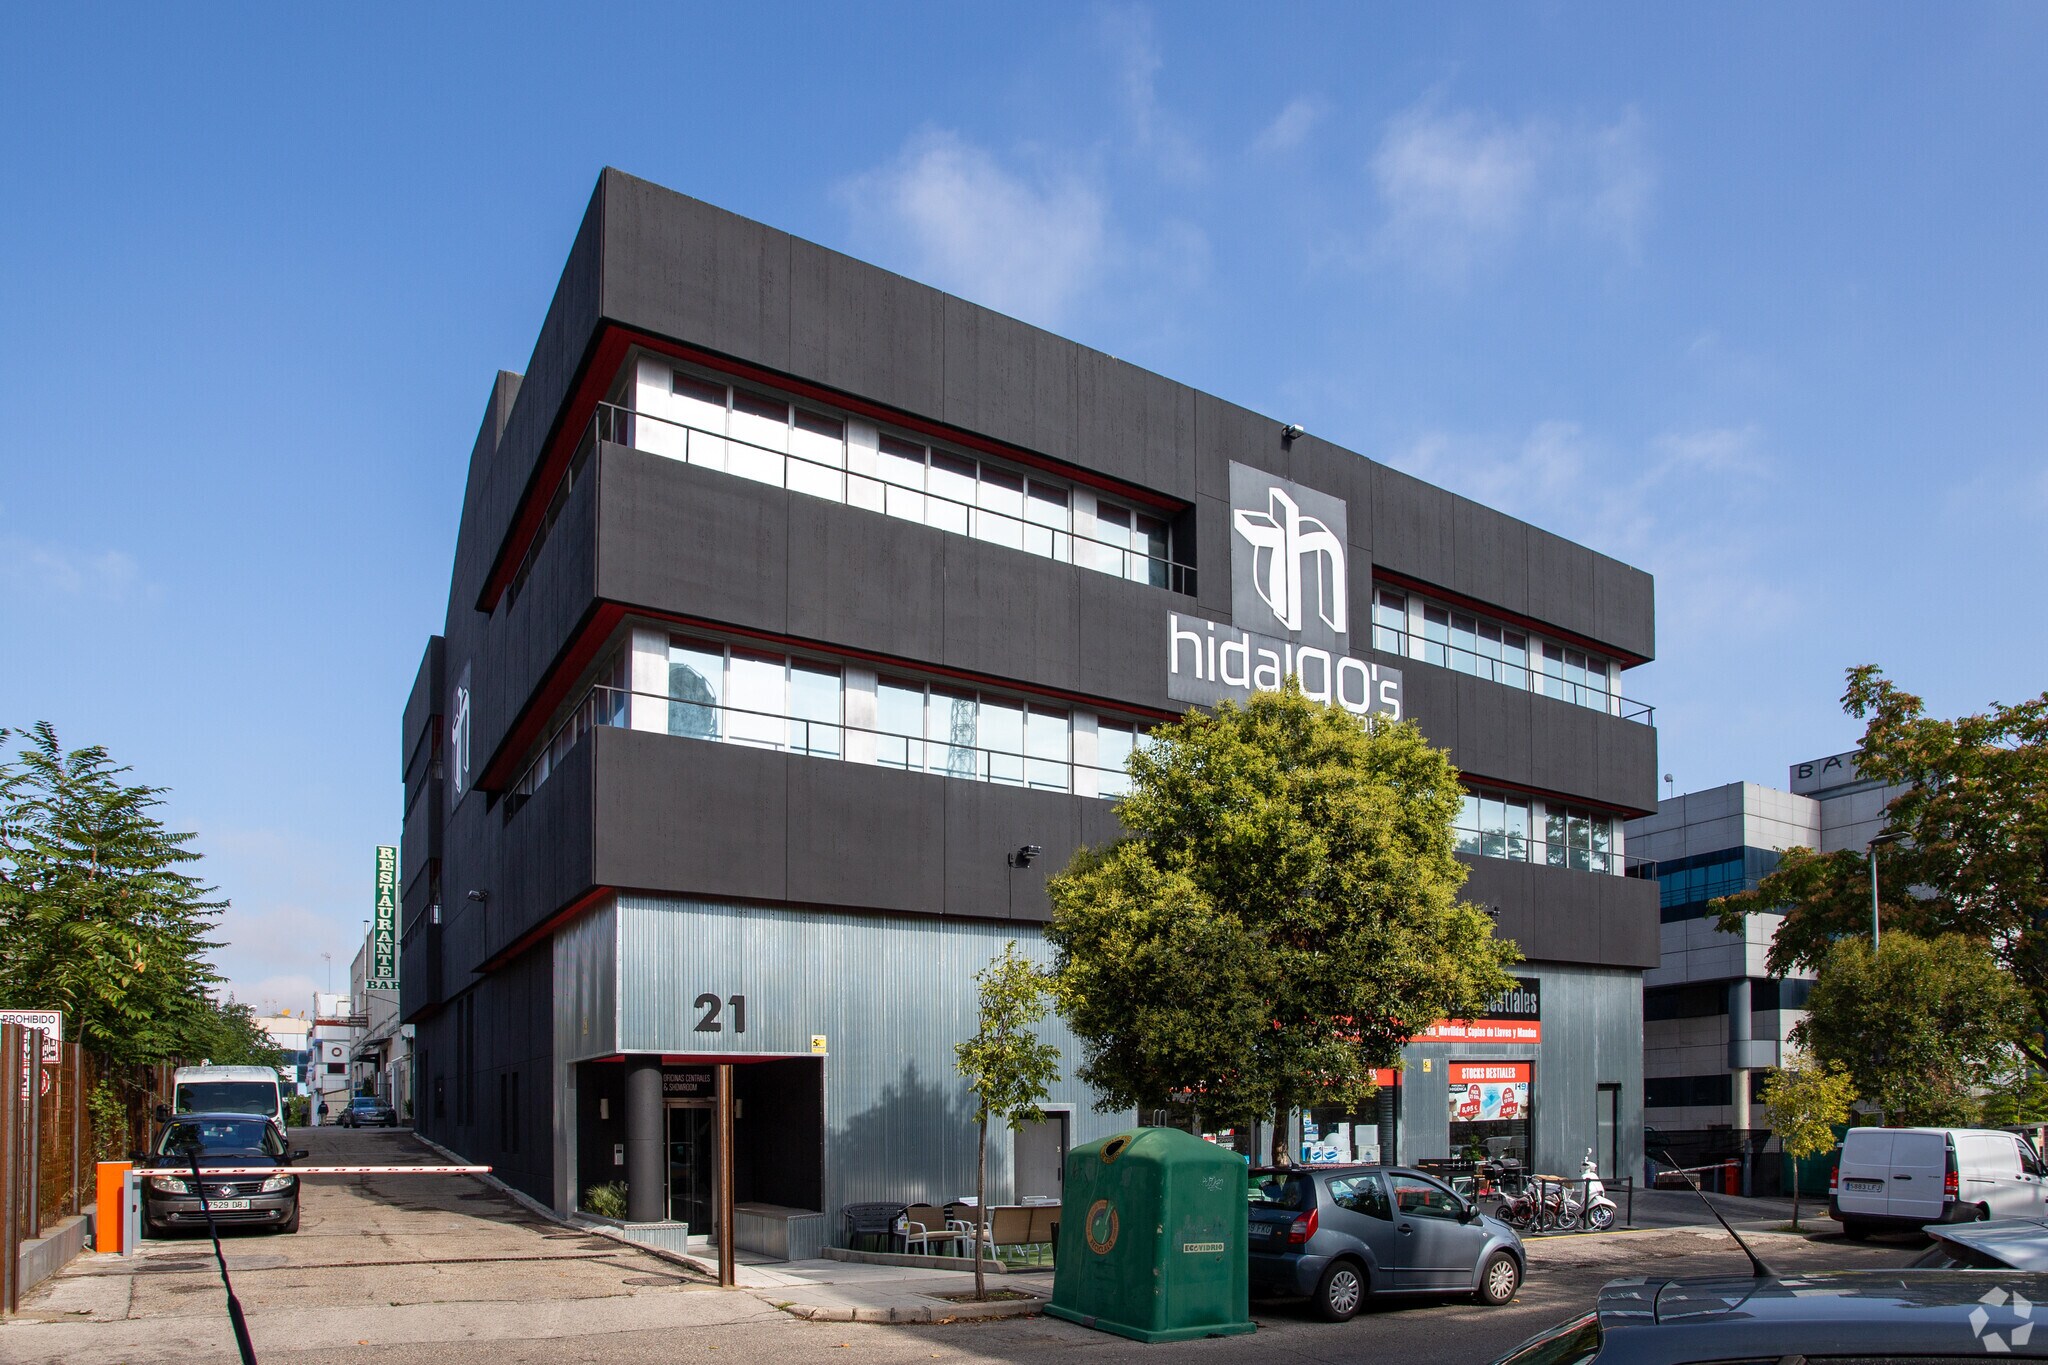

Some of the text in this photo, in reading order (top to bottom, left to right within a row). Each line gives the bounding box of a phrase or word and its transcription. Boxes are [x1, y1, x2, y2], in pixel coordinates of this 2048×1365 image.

[1169, 614, 1400, 723] hidalgo's
[376, 846, 395, 978] RESTAURANTE
[693, 993, 745, 1033] 21
[2, 1014, 56, 1024] PROHIBIDO
[662, 1073, 711, 1083] OFICINAS CENTRALES
[1461, 1067, 1516, 1080] STOCKS BESTIALES
[669, 1083, 698, 1091] SHOWROOM
[1184, 1244, 1223, 1252] ECOVIDRIO
